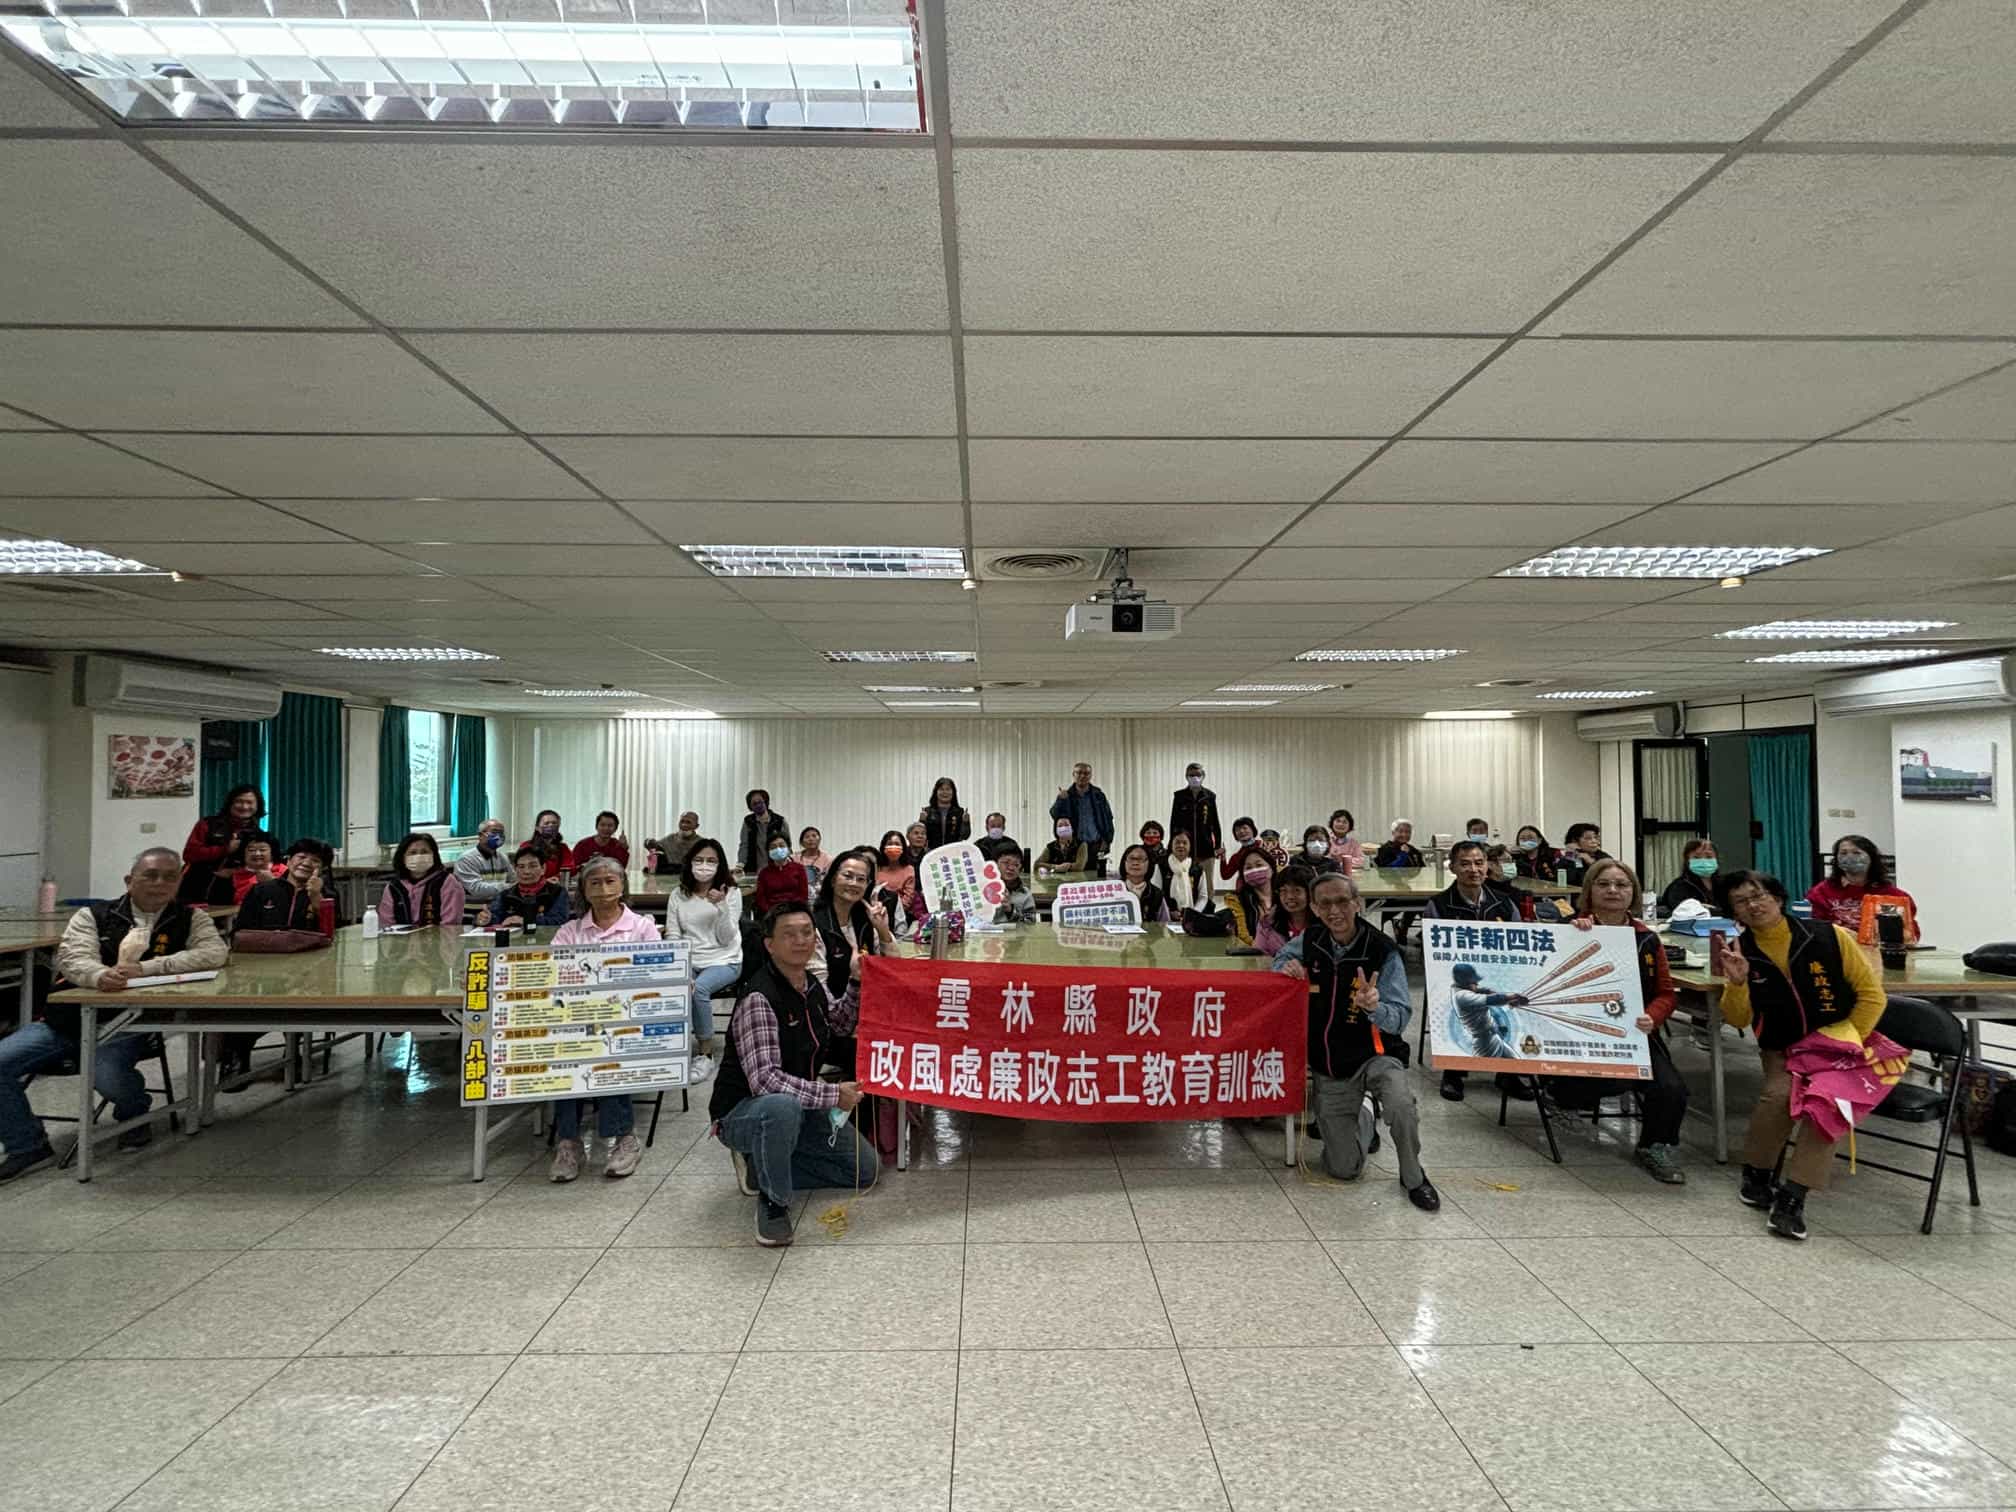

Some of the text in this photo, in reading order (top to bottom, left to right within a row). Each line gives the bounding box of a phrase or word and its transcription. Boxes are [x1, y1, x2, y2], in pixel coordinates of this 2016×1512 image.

[1430, 925, 1556, 953] 打詐新四法
[463, 951, 490, 1101] 反詐騙 八部曲
[936, 977, 1226, 1038] 雲林縣政府
[870, 1039, 1286, 1107] 政風處廉政志工教育訓練
